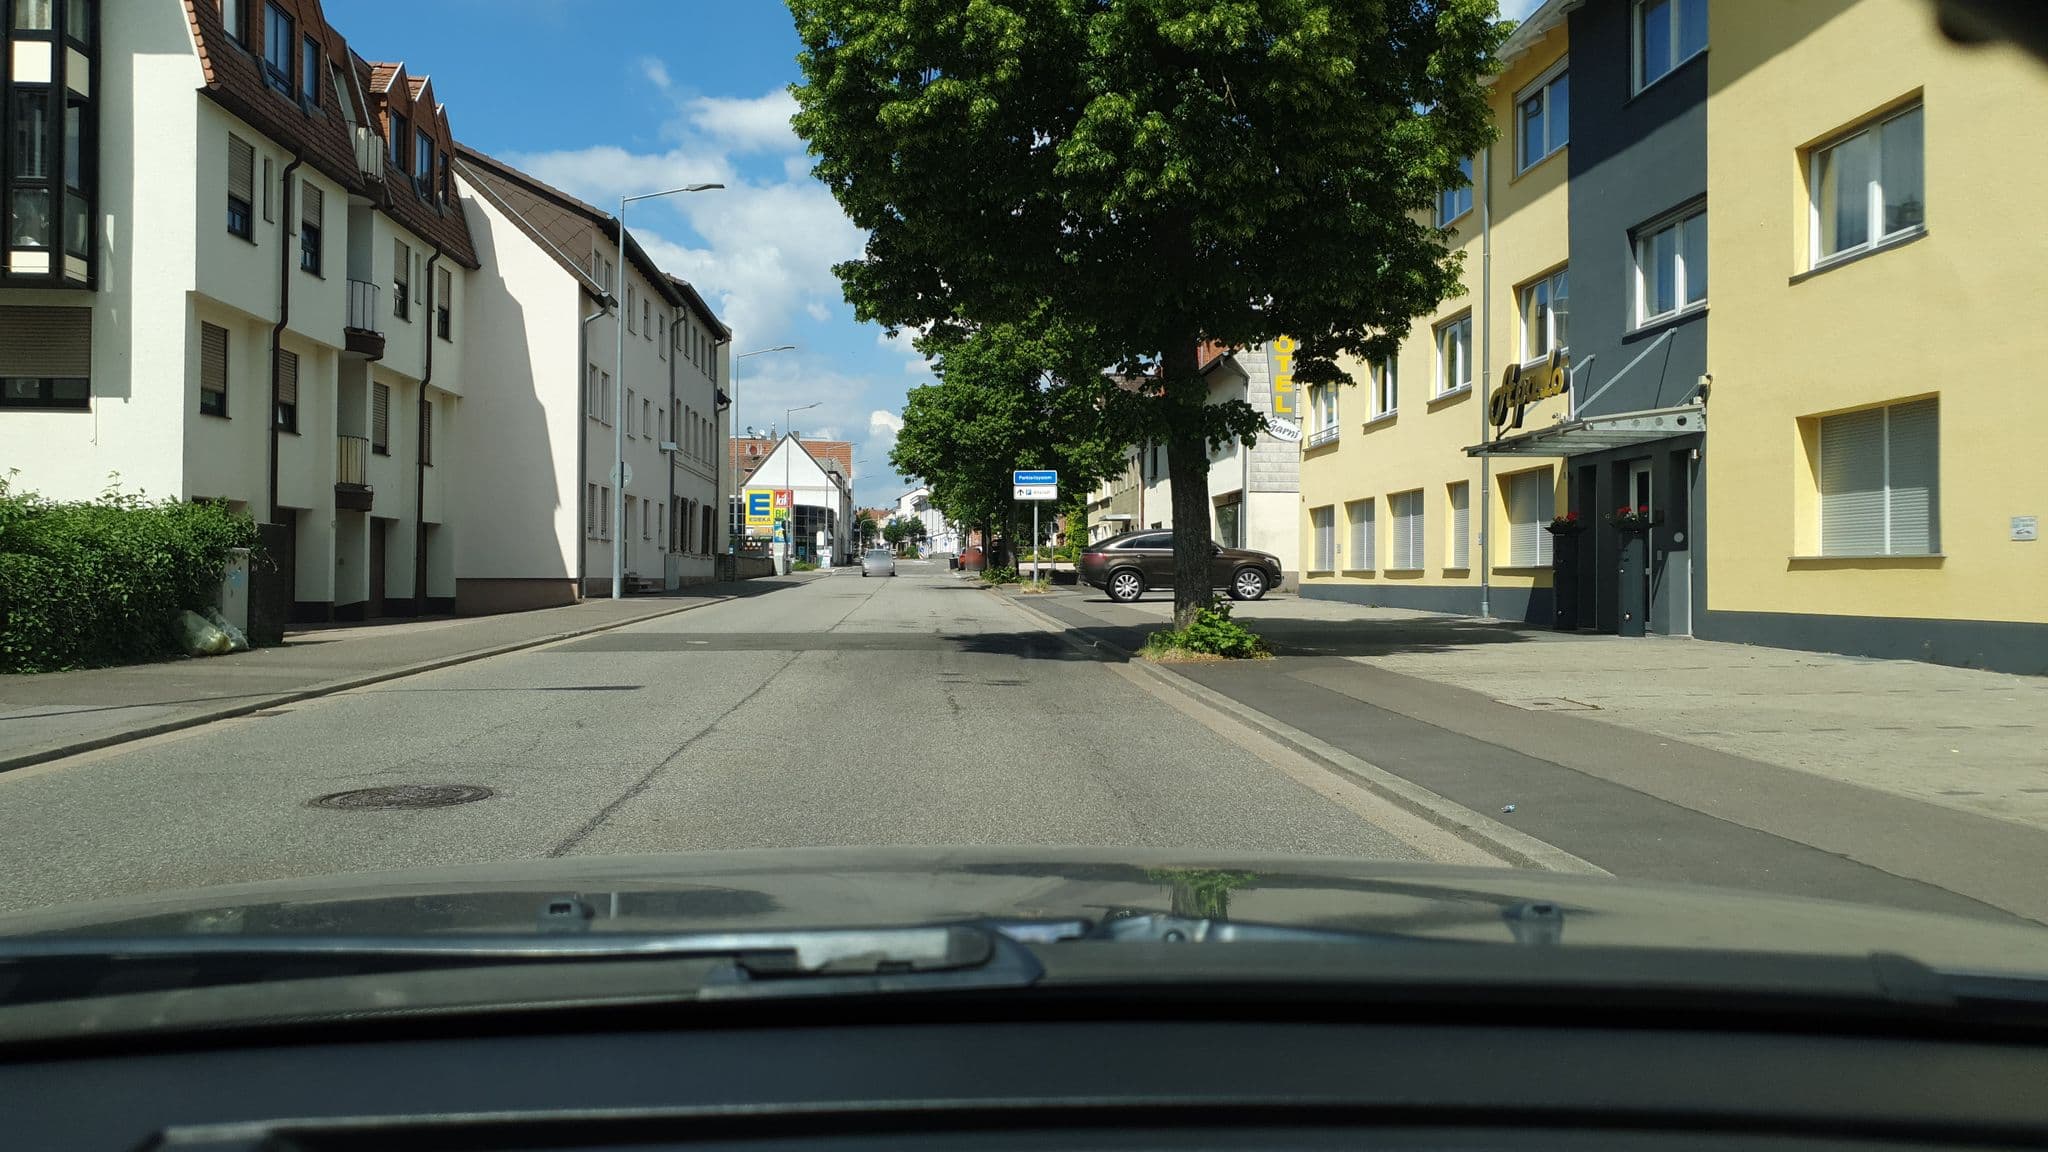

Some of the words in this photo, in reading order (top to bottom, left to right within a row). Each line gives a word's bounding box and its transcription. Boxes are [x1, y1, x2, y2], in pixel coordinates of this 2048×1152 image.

[1273, 335, 1296, 413] OTEL
[1268, 419, 1301, 440] Garni
[749, 493, 770, 516] E
